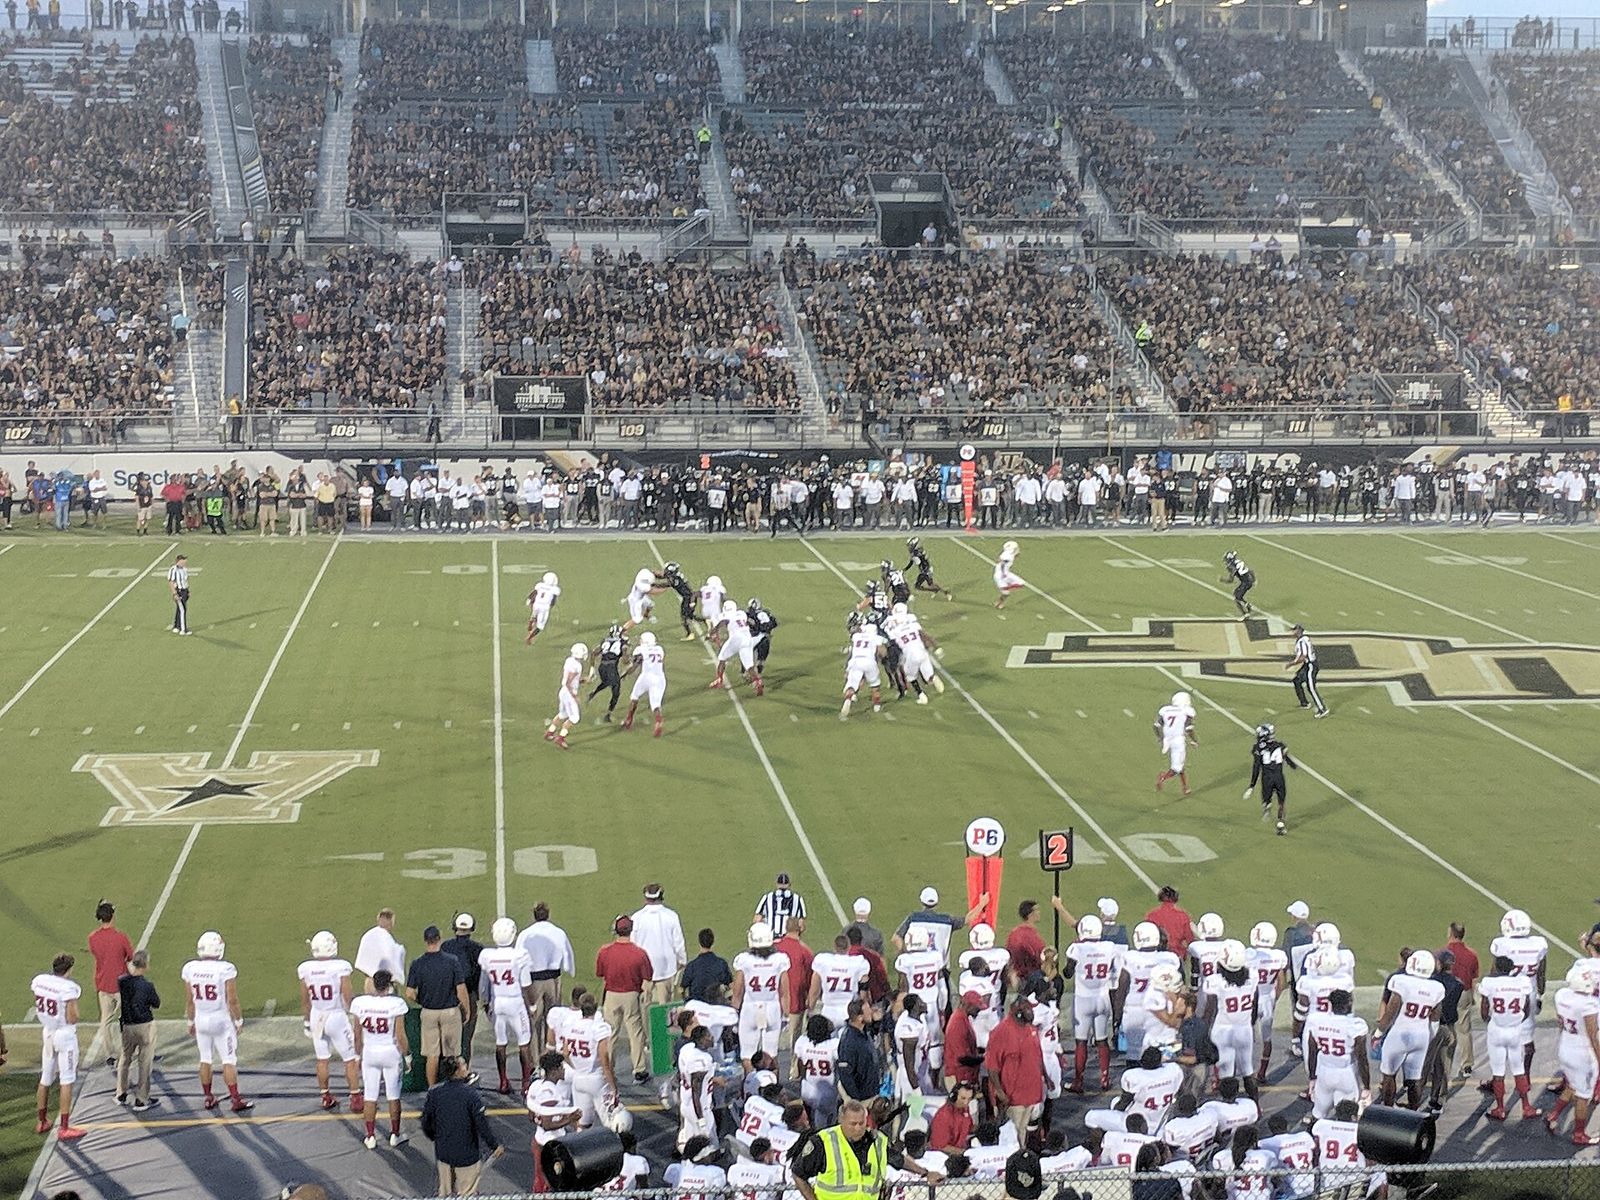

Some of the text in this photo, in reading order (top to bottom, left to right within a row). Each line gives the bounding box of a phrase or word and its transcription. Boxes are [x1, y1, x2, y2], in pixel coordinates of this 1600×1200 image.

[4, 426, 32, 440] 107
[330, 425, 357, 437] 108
[620, 425, 645, 437] 109
[982, 423, 1004, 436] 110
[1289, 421, 1306, 432] 111
[1167, 716, 1177, 728] 7
[972, 827, 998, 846] P6
[1048, 834, 1068, 865] 2
[400, 844, 599, 880] 30
[489, 968, 515, 985] 14
[749, 974, 777, 992] 44
[826, 975, 852, 992] 71
[912, 970, 937, 990] 83
[1258, 968, 1281, 985] 87
[192, 983, 218, 1001] 16
[307, 983, 333, 1001] 10
[1404, 1001, 1433, 1020] 90
[1492, 997, 1521, 1015] 84
[362, 1017, 390, 1034] 48
[1317, 1037, 1346, 1056] 55
[1326, 1139, 1358, 1163] 94
